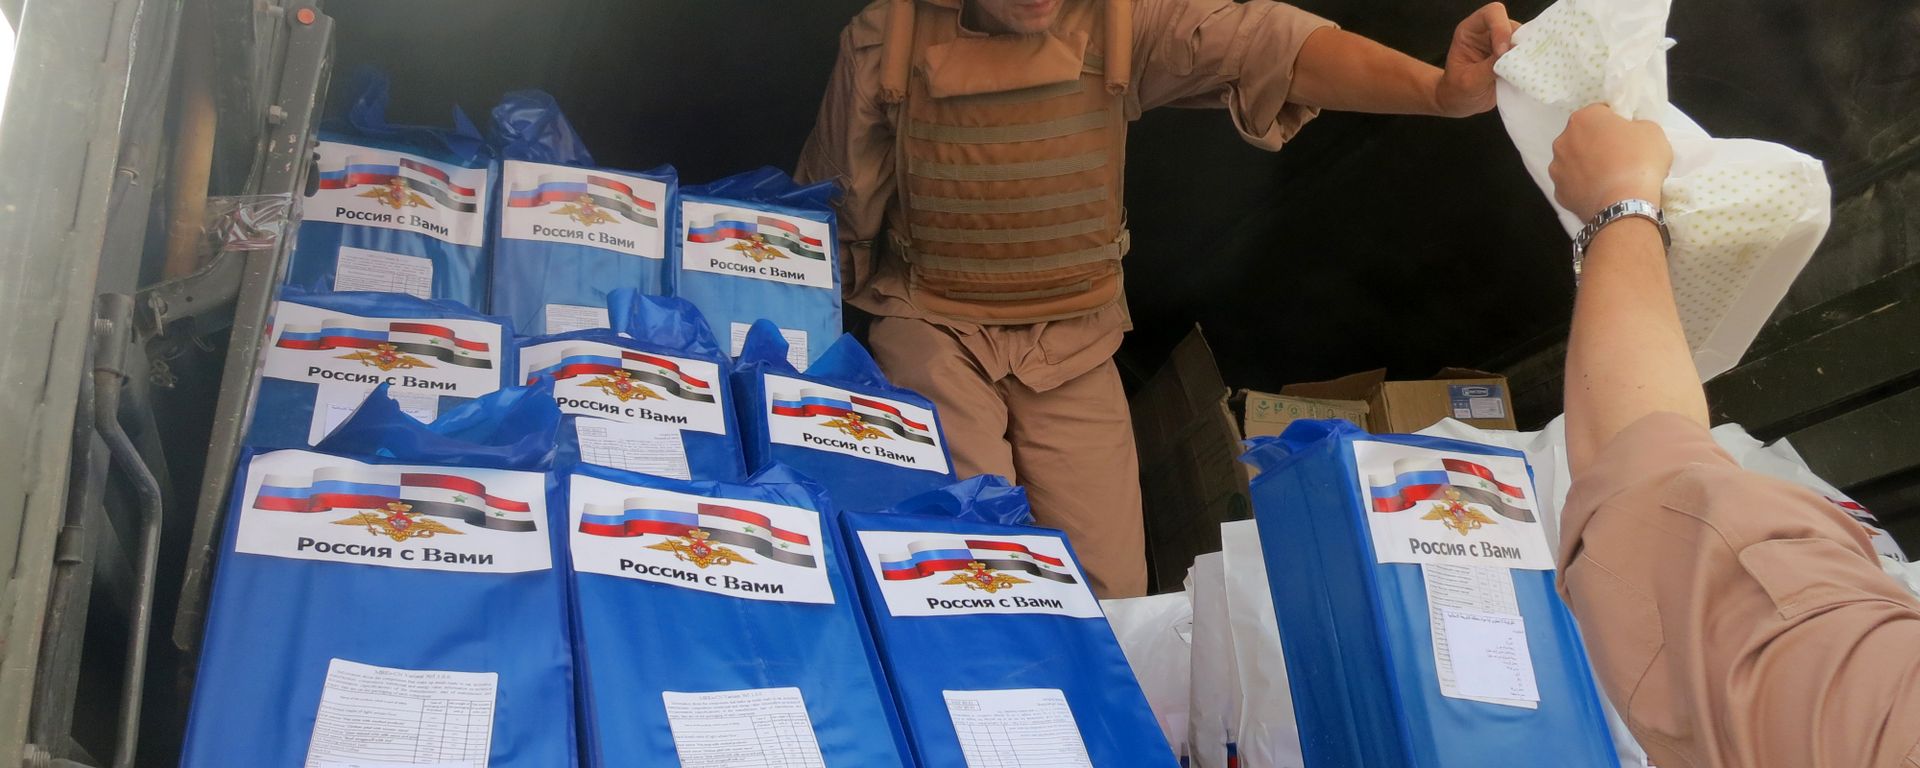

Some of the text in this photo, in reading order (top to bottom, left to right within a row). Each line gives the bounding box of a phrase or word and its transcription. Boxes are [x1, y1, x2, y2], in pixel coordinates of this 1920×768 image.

[336, 207, 449, 237] Россия с Вами
[533, 224, 636, 249] Россия с Вами
[710, 258, 806, 281] Россия с Вами
[307, 366, 457, 391] Россия с Вами
[556, 396, 688, 425] Россия с Вами
[802, 432, 916, 464] Россия с Вами
[297, 536, 494, 566] Россия с Вами
[1408, 537, 1522, 560] Россия с Вами
[619, 558, 784, 595] Россия с Вами
[926, 596, 1064, 610] Россия с Вами
